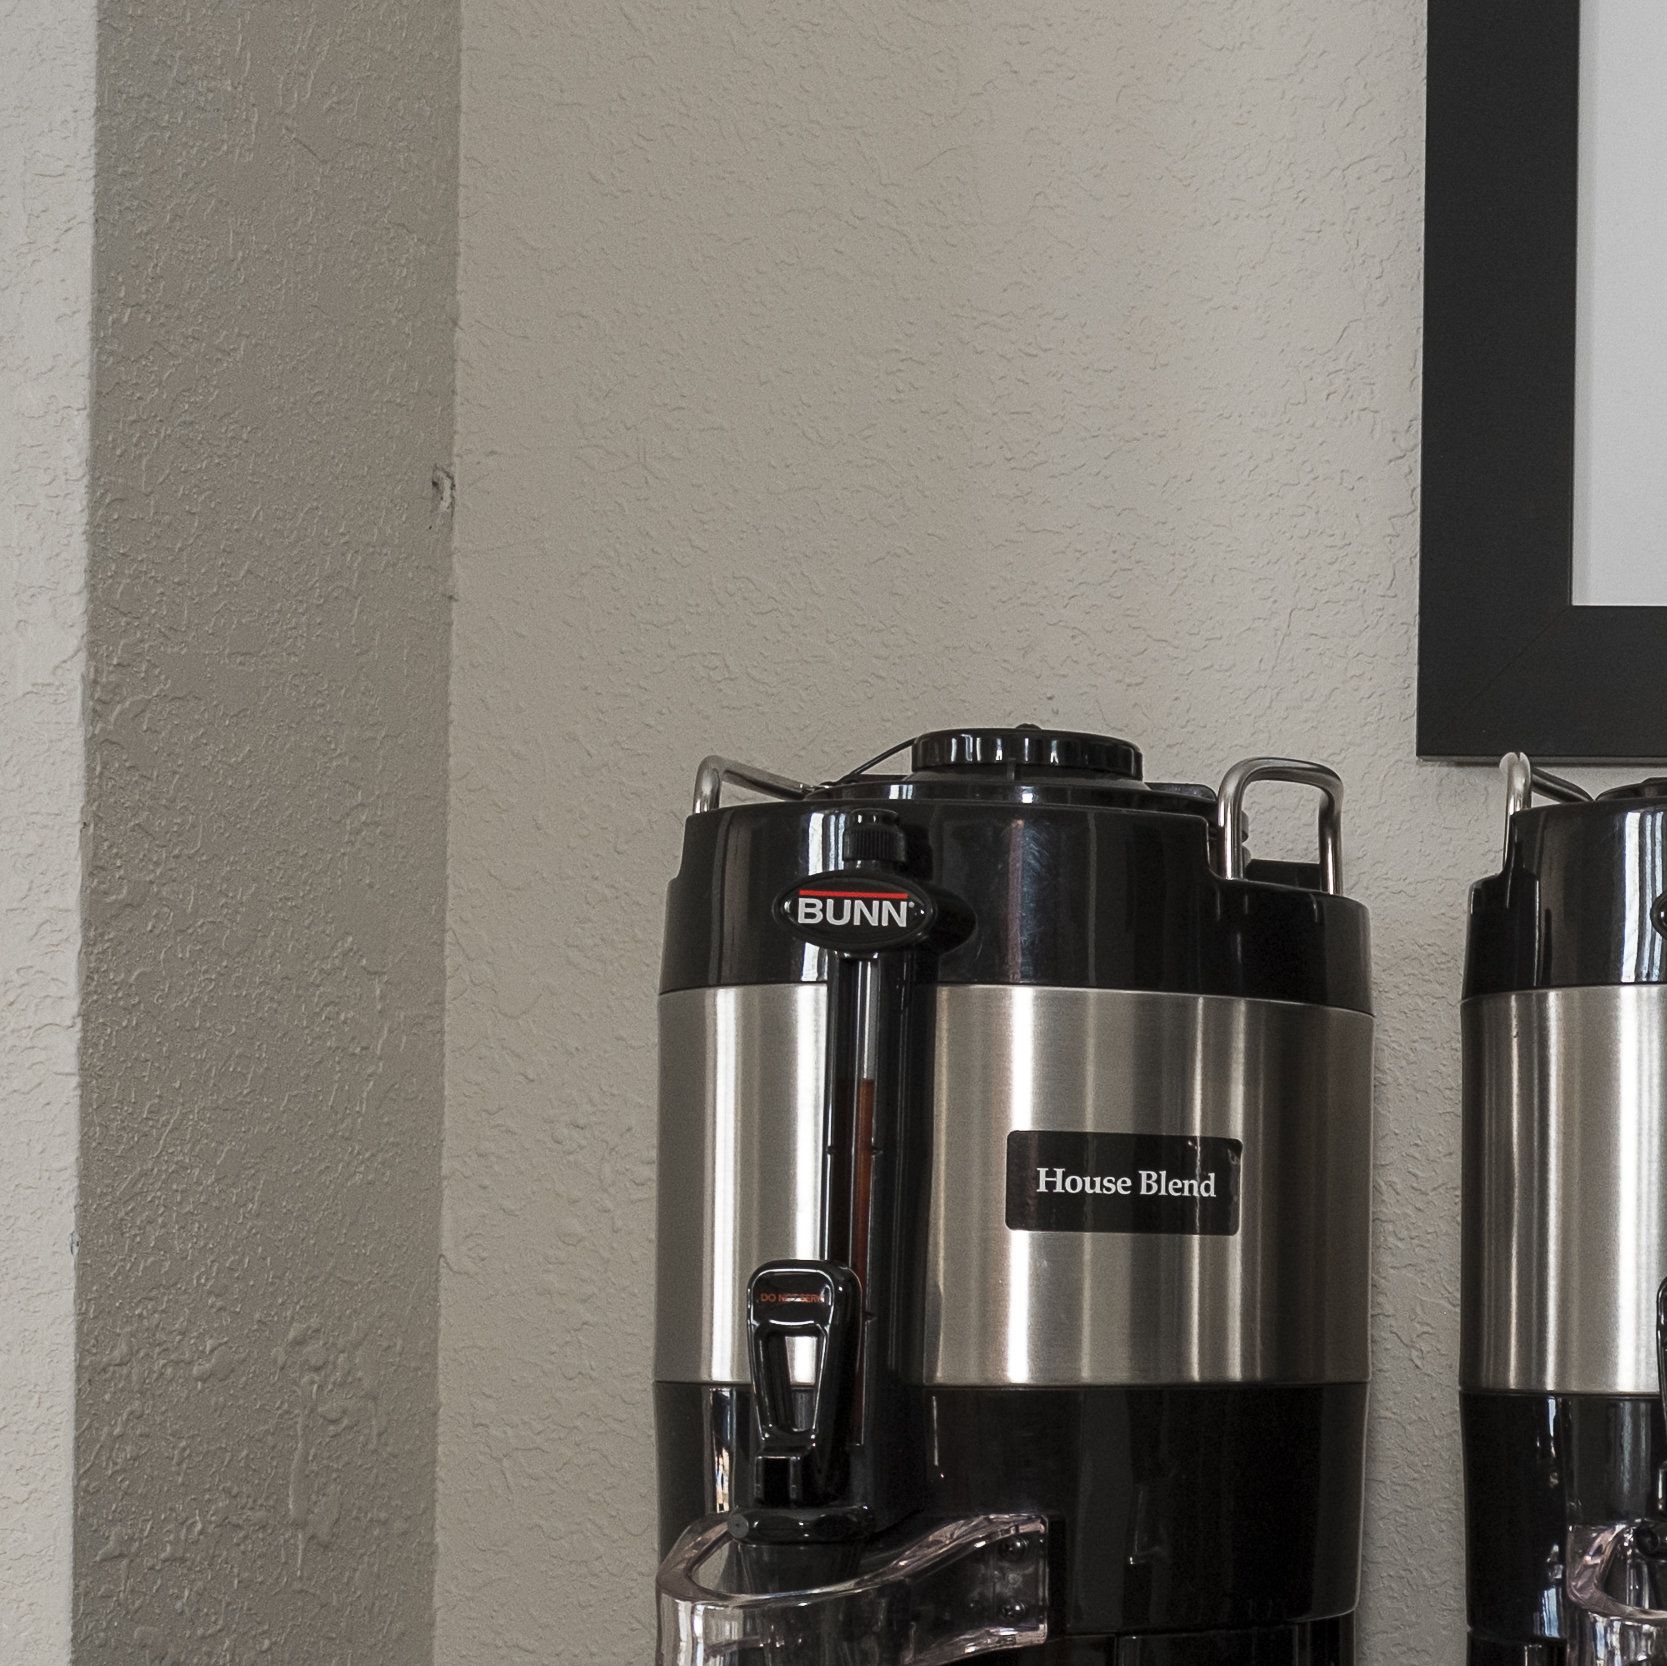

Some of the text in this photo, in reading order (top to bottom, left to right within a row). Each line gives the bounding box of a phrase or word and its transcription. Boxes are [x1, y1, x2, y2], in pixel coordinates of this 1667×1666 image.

[798, 897, 908, 928] BUNN
[1037, 1168, 1217, 1198] House Blend
